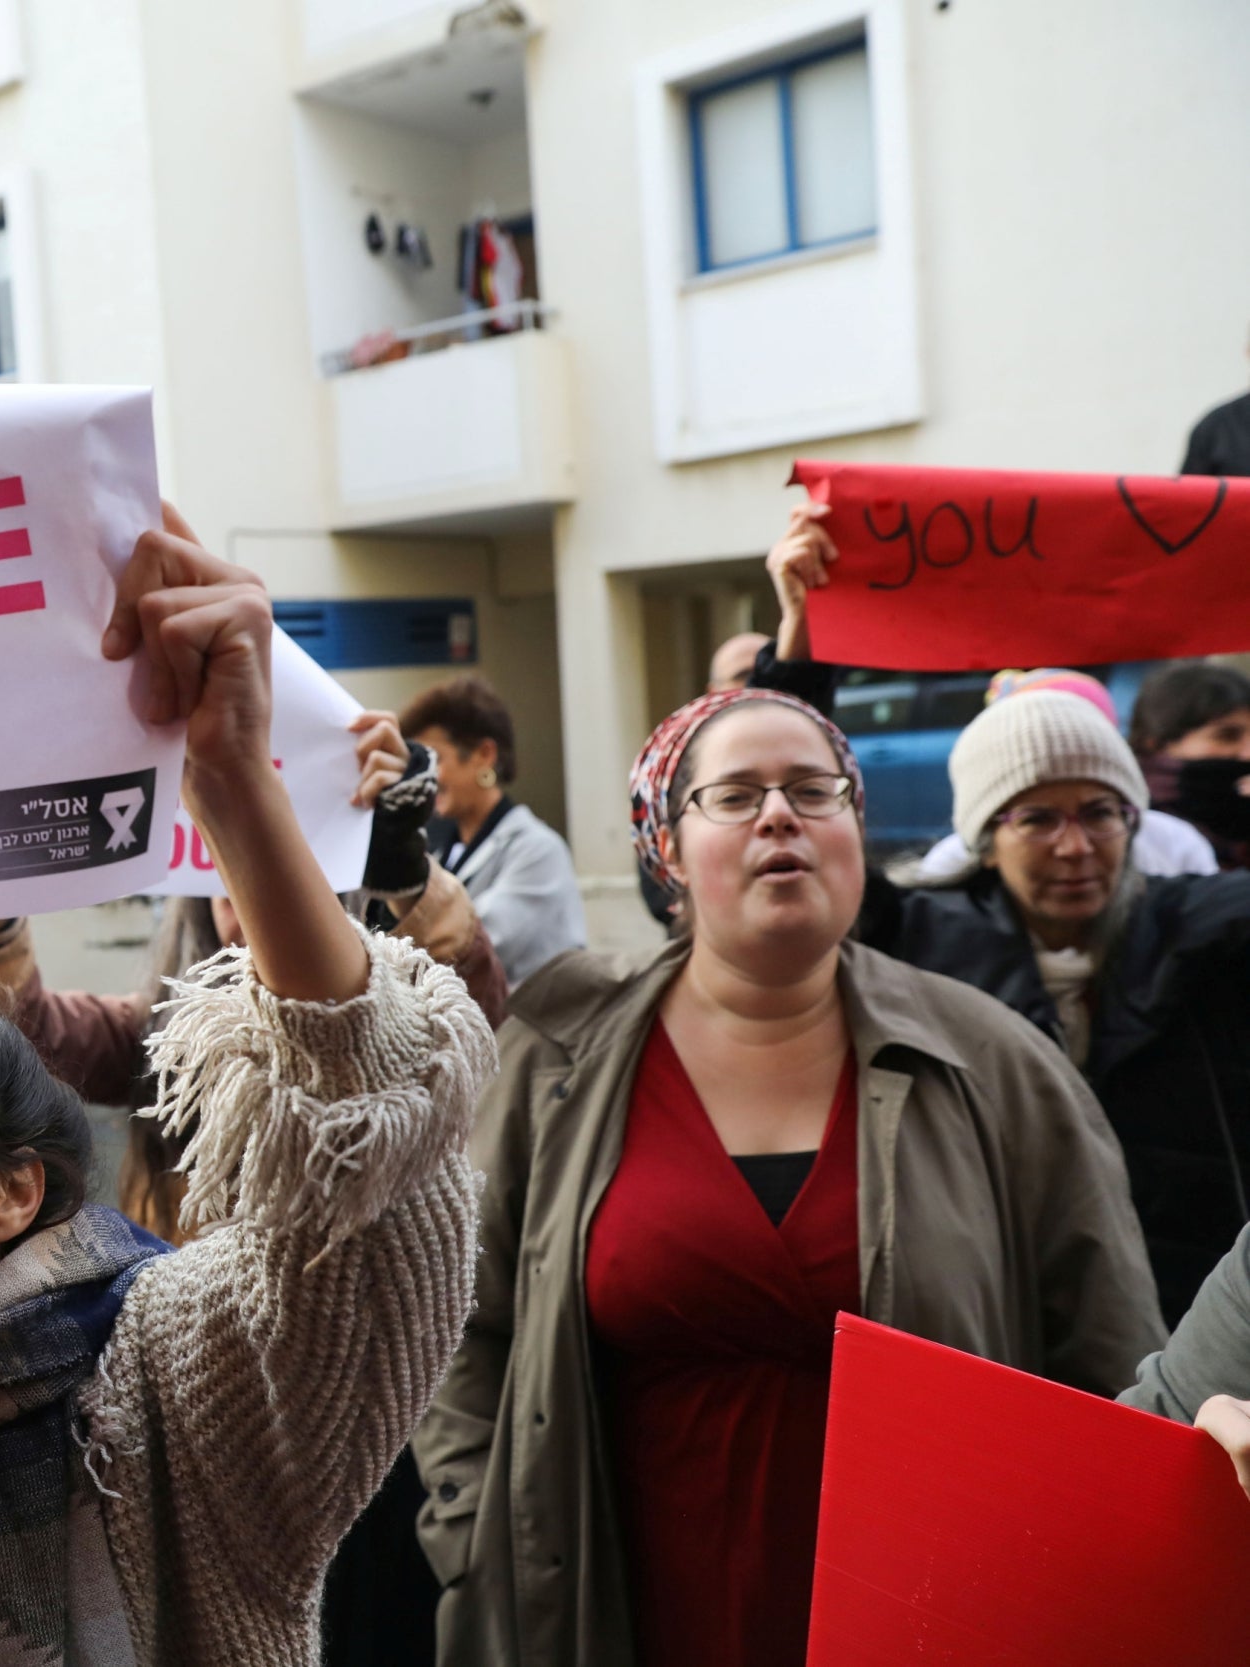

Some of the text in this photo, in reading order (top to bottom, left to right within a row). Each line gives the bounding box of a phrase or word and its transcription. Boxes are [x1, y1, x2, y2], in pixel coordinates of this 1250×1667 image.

[864, 496, 1046, 590] you
[56, 825, 91, 843] ארגון
[48, 844, 90, 861] ישראל
